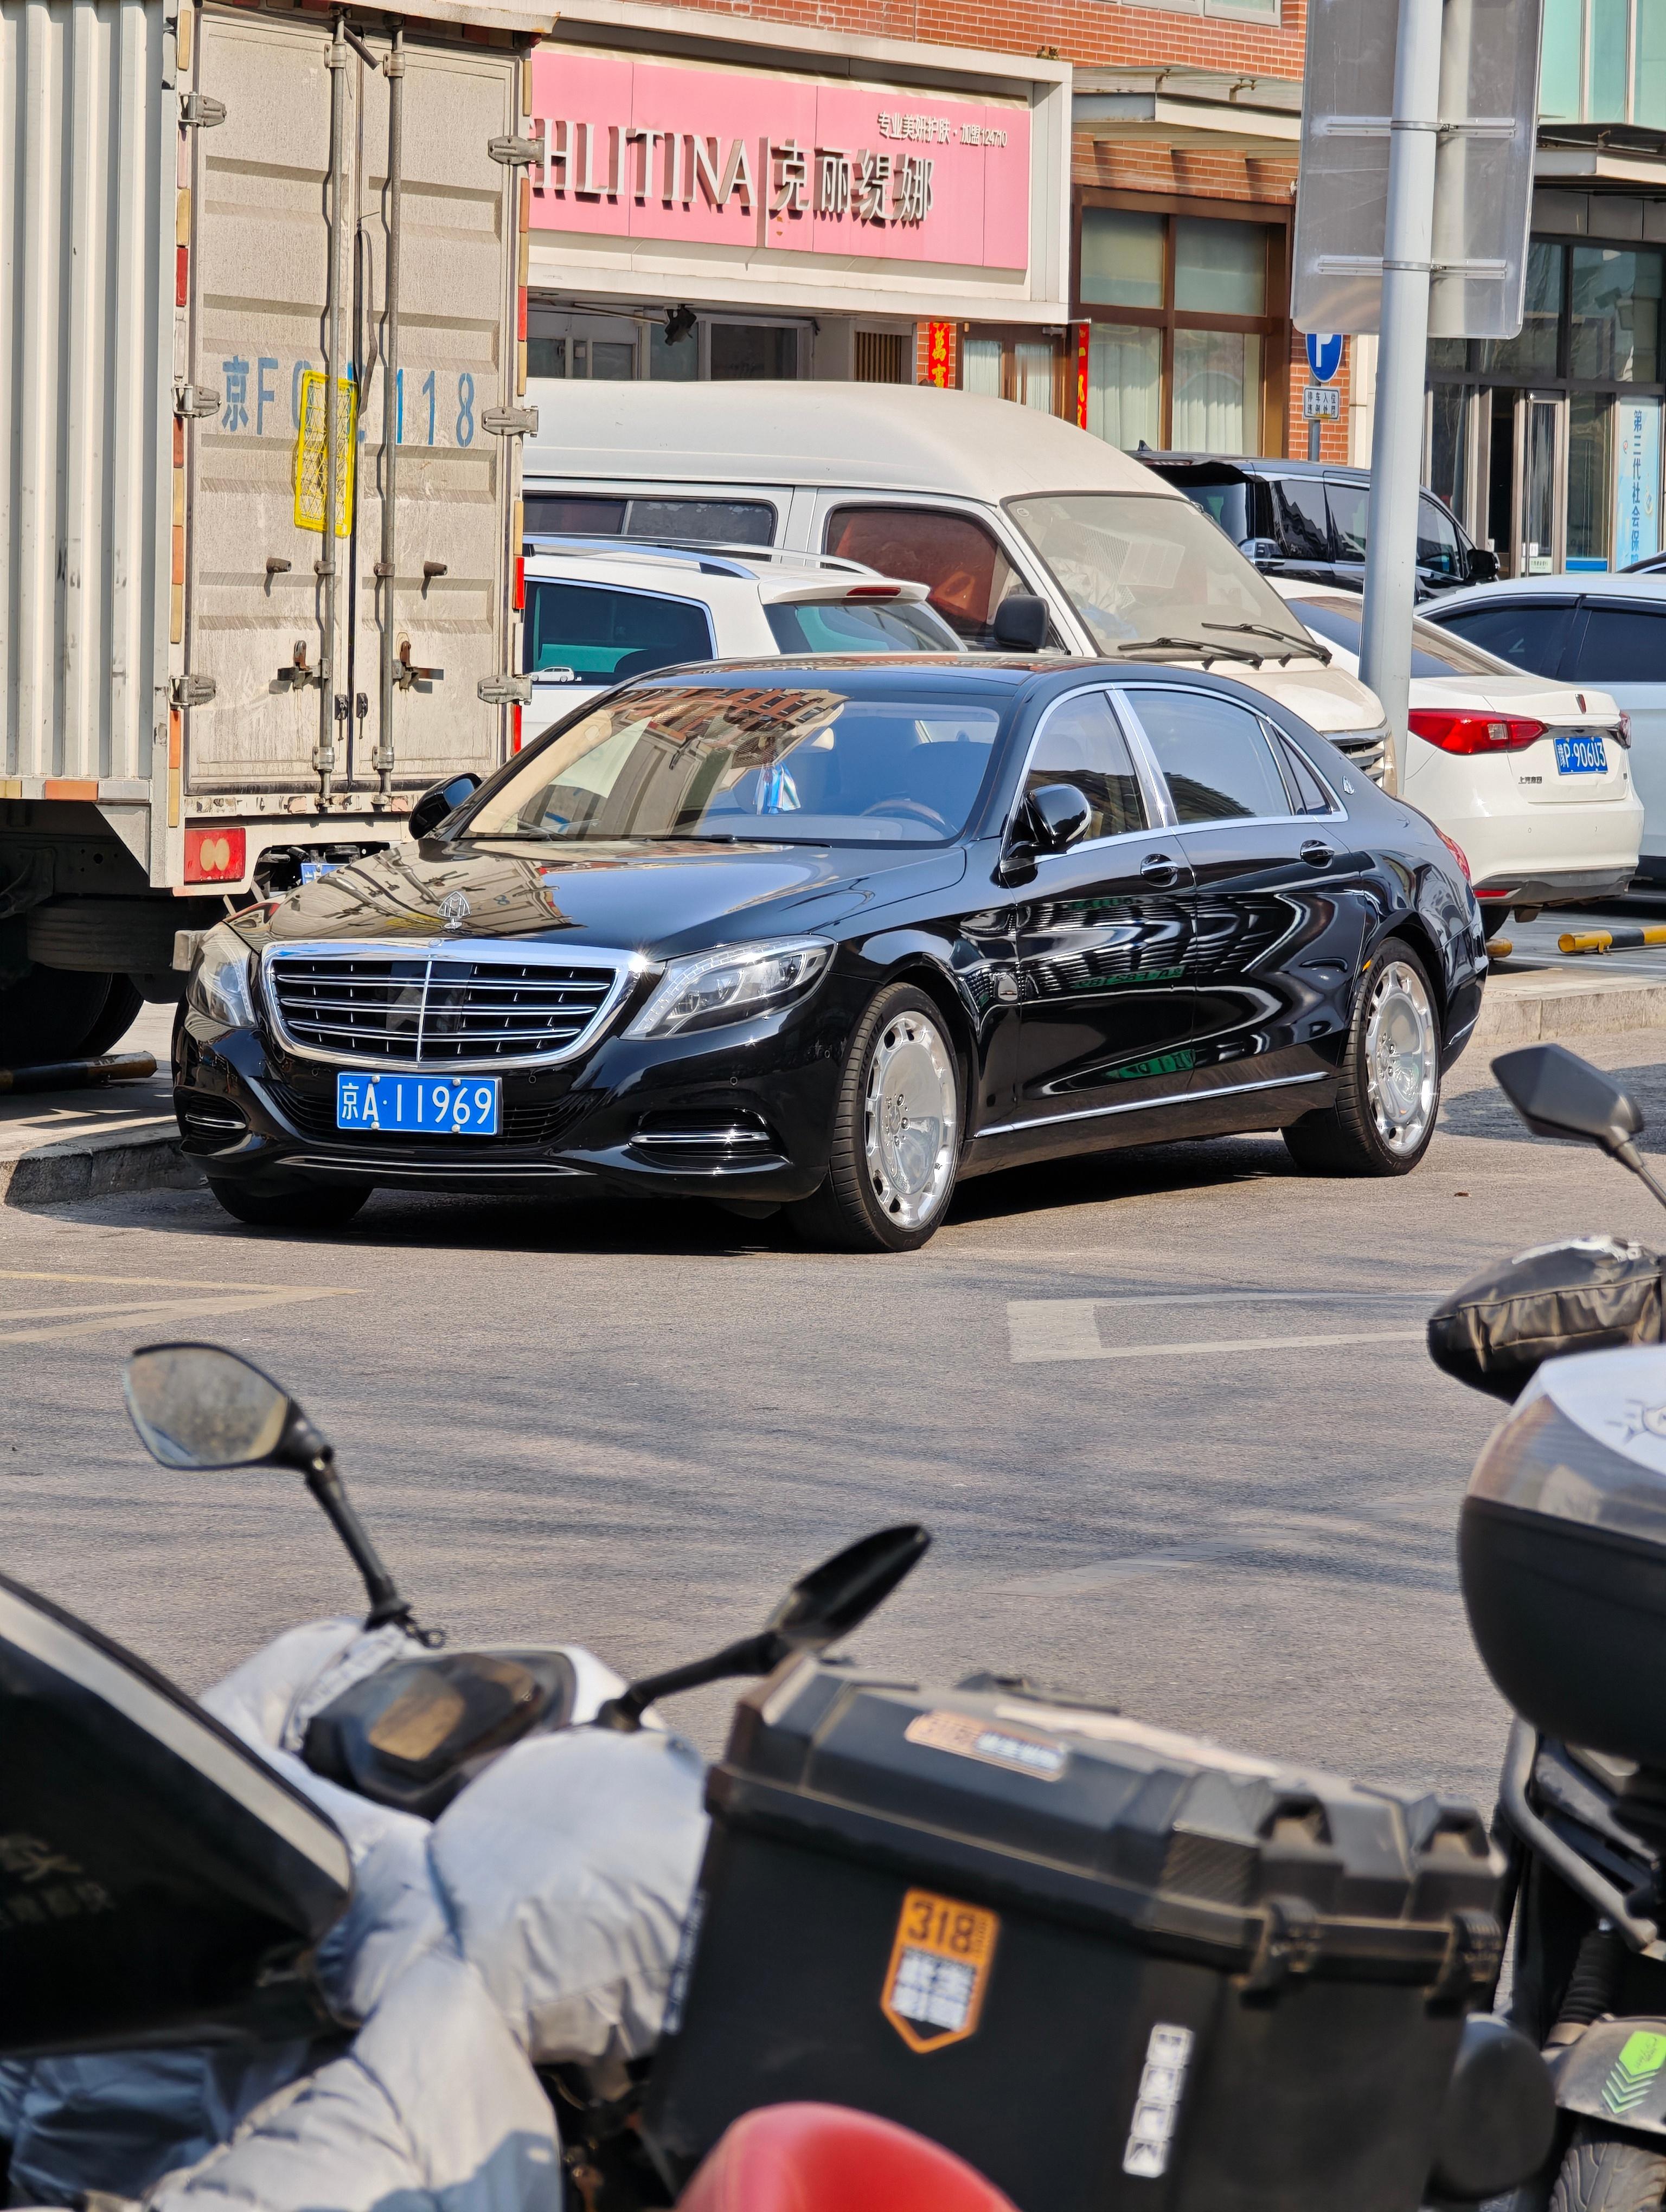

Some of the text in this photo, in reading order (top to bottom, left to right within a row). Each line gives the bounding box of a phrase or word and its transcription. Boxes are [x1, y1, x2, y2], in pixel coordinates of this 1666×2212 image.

[528, 117, 758, 208] HLITINA
[770, 139, 934, 222] 克丽缇娜
[342, 1082, 492, 1125] 京A·11969
[908, 1901, 975, 1954] 318
